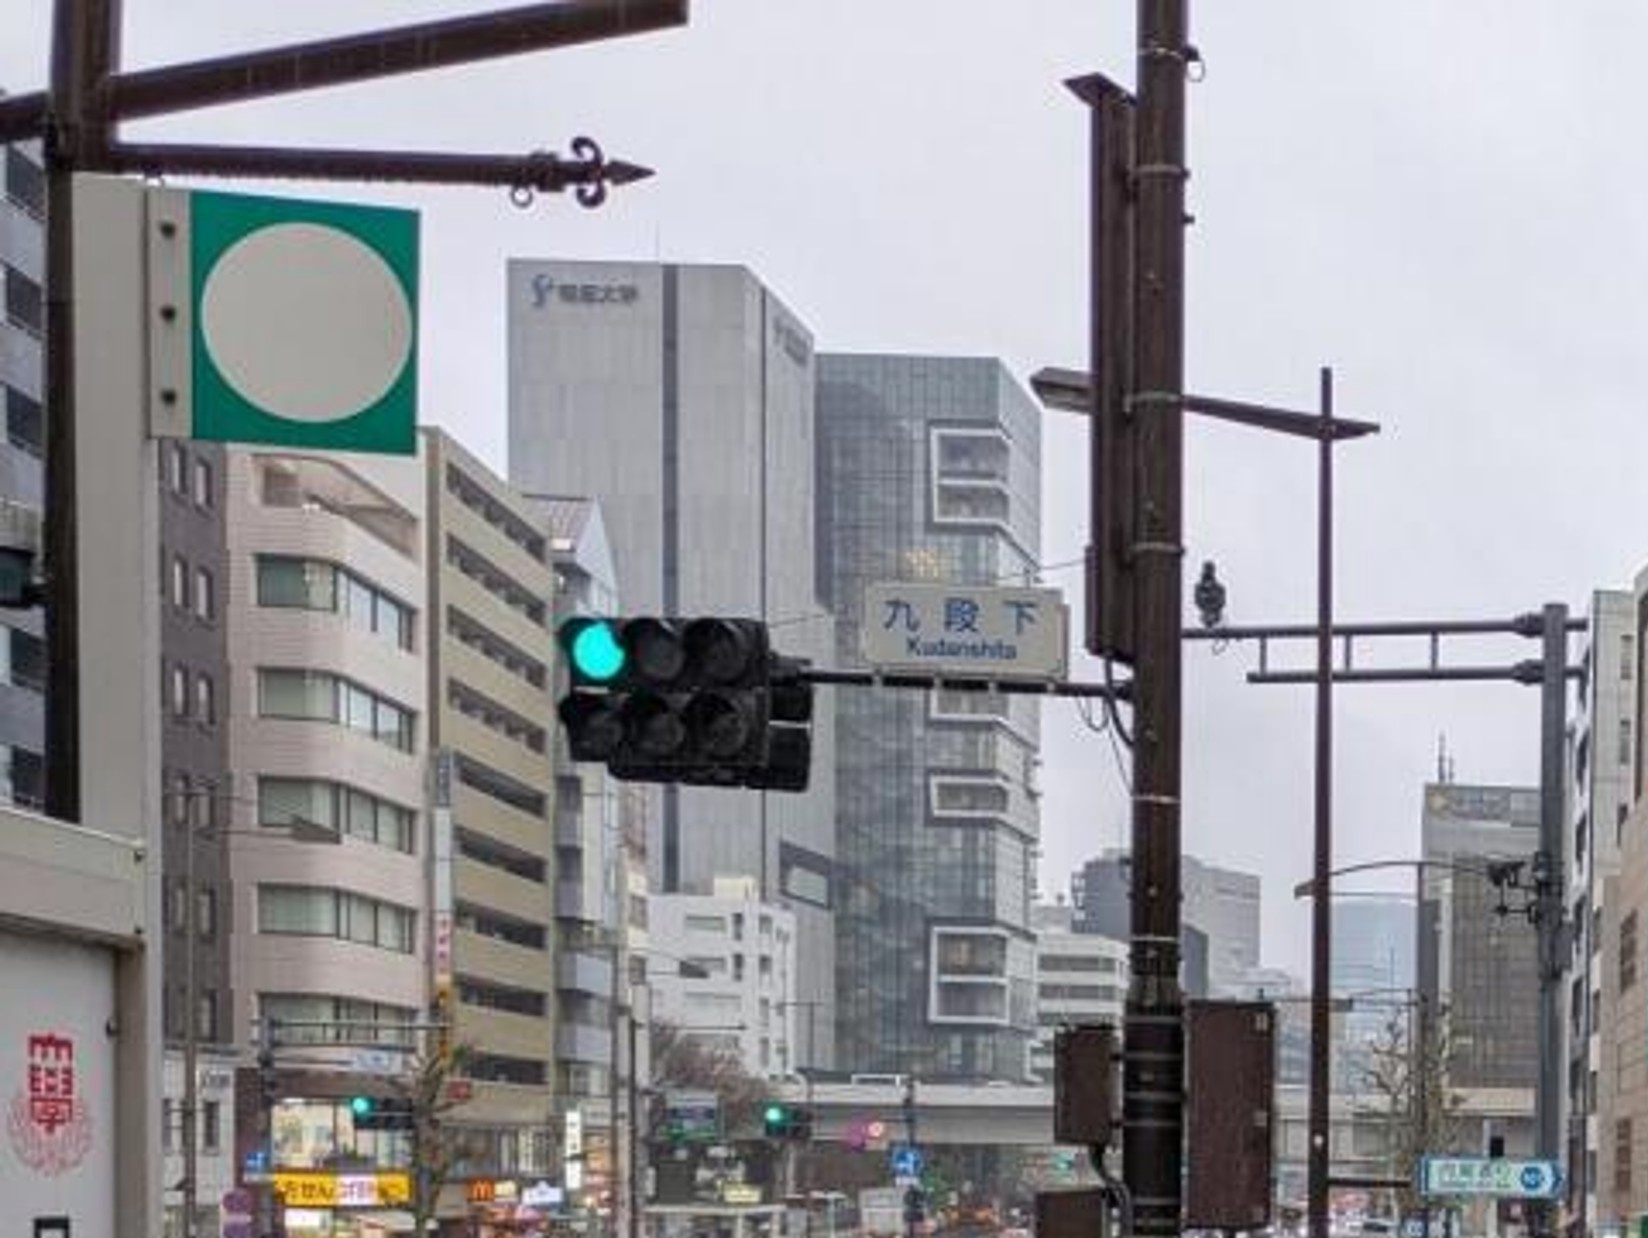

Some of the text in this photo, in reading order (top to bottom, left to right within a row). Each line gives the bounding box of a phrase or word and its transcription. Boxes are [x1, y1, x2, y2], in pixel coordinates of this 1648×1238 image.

[884, 598, 1036, 634] 九段下
[906, 637, 1018, 659] Kudanshita
